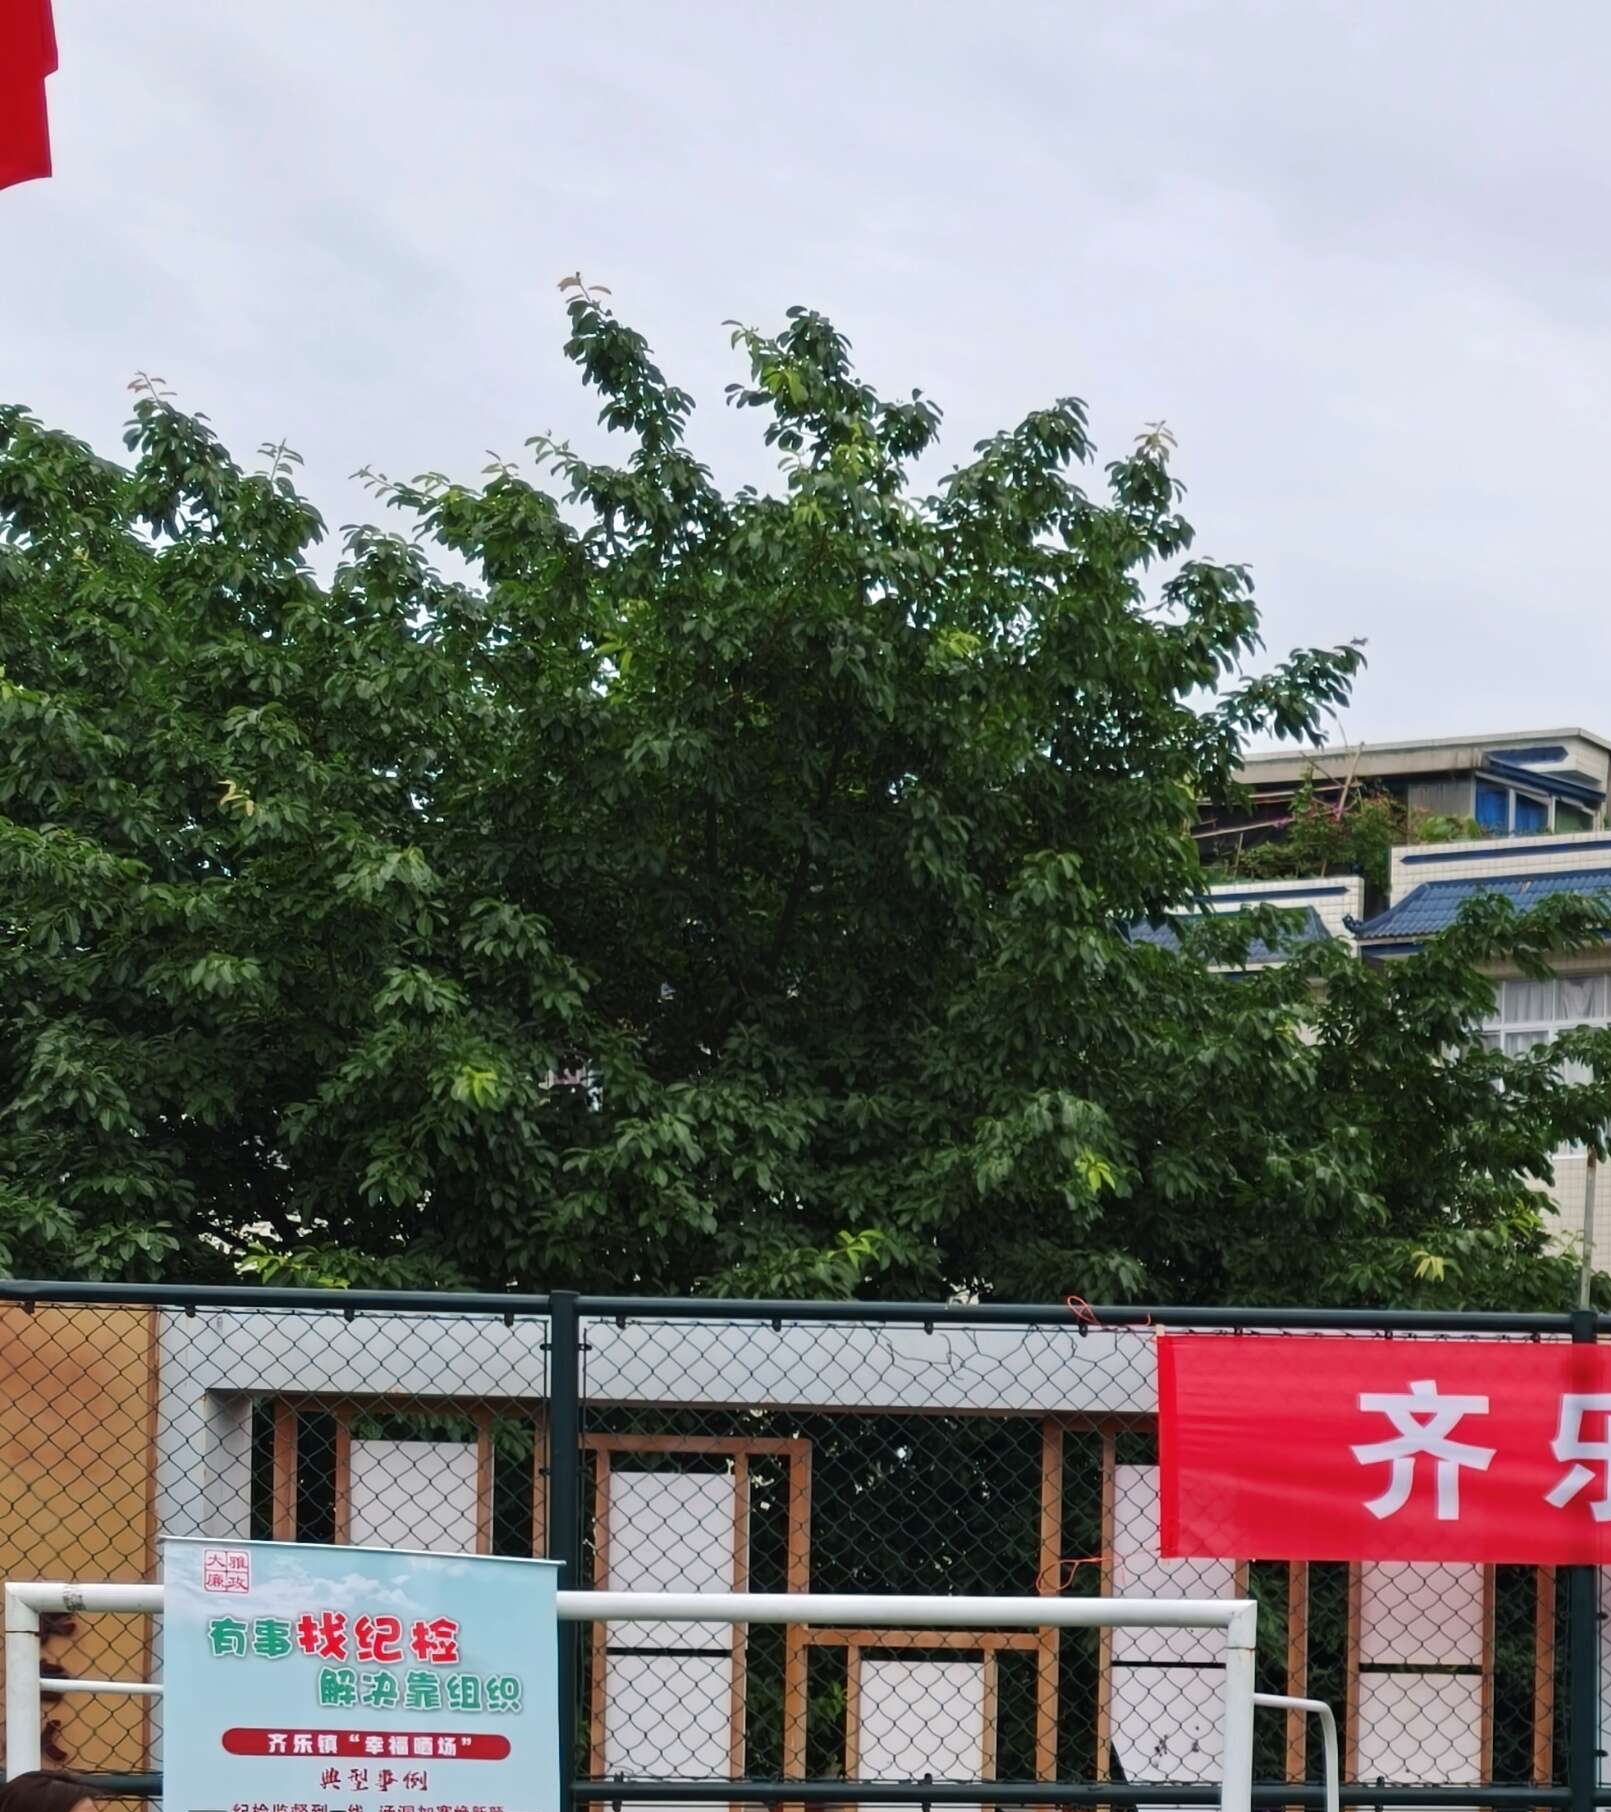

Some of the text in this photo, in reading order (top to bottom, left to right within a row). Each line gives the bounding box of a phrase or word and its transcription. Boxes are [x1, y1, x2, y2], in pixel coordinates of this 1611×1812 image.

[206, 1610, 462, 1665] 有事找纪检
[318, 1667, 525, 1714] 解决靠组织
[267, 1732, 474, 1758] 齐乐镇“幸福晒场”
[320, 1767, 429, 1793] 典型事例
